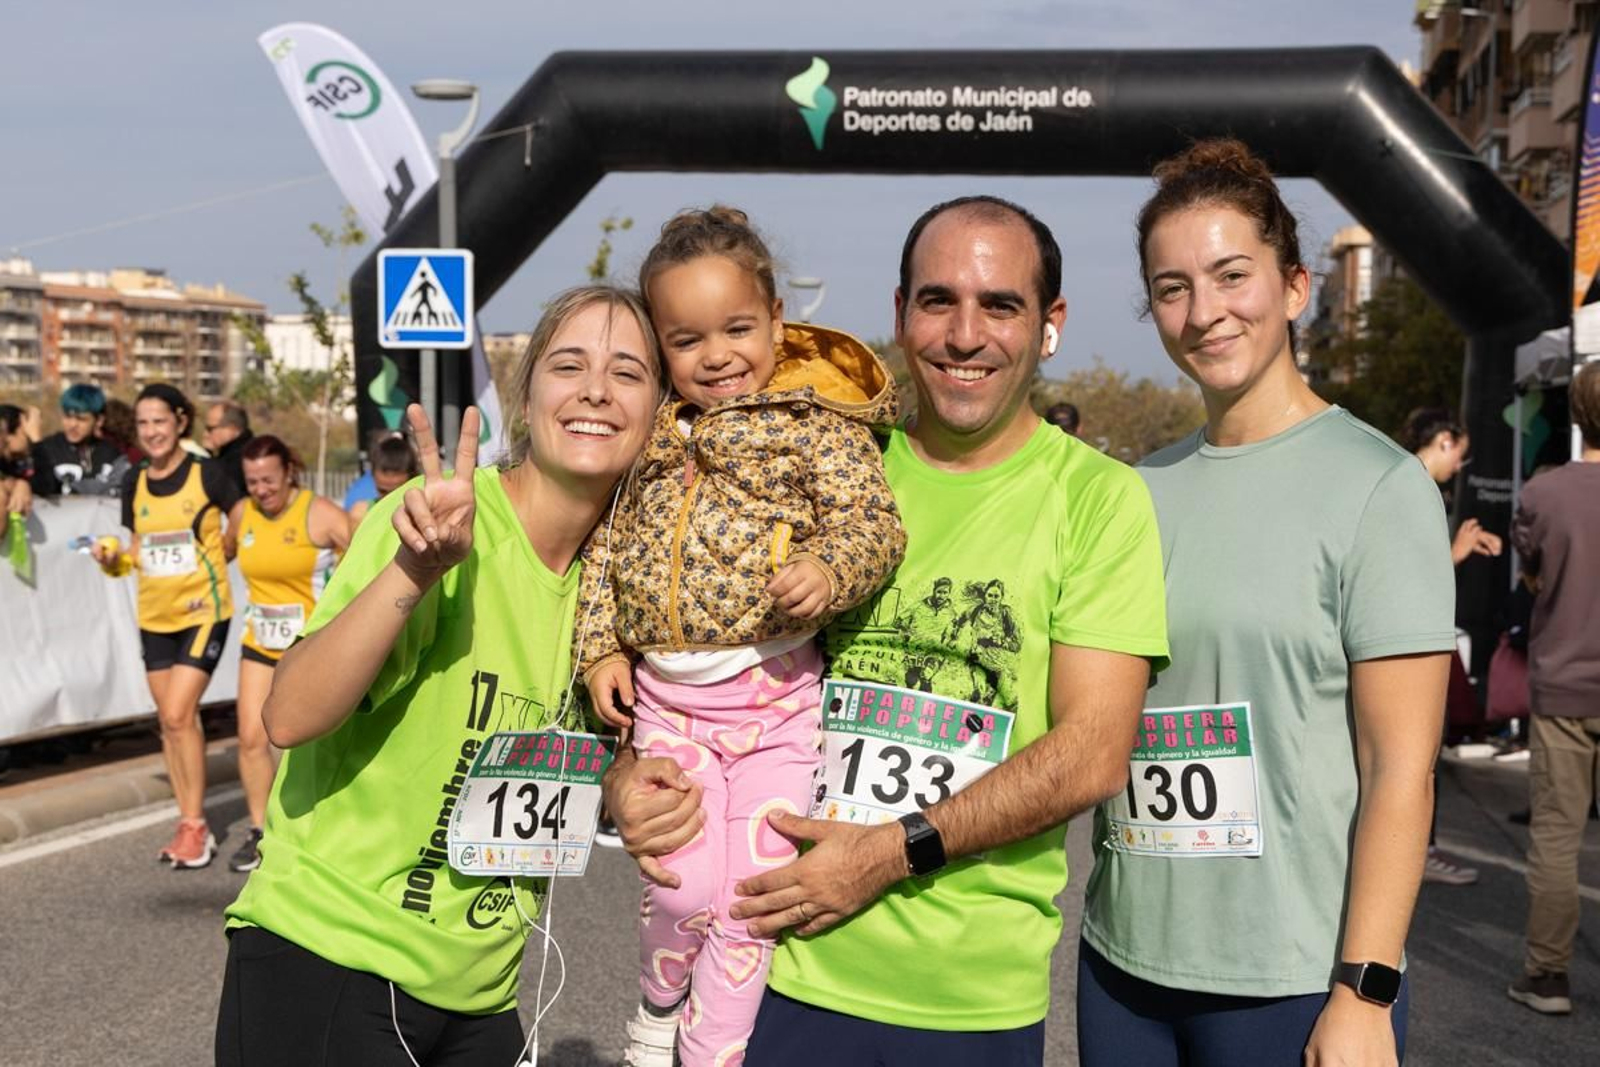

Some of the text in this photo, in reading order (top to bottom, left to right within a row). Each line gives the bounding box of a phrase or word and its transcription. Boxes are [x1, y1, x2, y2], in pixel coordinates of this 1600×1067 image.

[843, 86, 1092, 111] Patronato Municipal de
[843, 110, 1033, 136] Deportes de Jaén
[148, 547, 183, 565] 175
[260, 620, 292, 638] 176
[466, 670, 500, 732] 17
[858, 706, 993, 748] POPULAR
[1142, 711, 1236, 731] RRERA
[891, 731, 901, 741] de
[481, 736, 516, 766] XI
[1156, 750, 1183, 761] género
[1184, 751, 1191, 759] y
[1191, 749, 1200, 758] la
[1201, 747, 1237, 758] igualdad
[840, 737, 955, 811] 133
[487, 780, 571, 840] 134
[478, 892, 516, 913] CSIF
